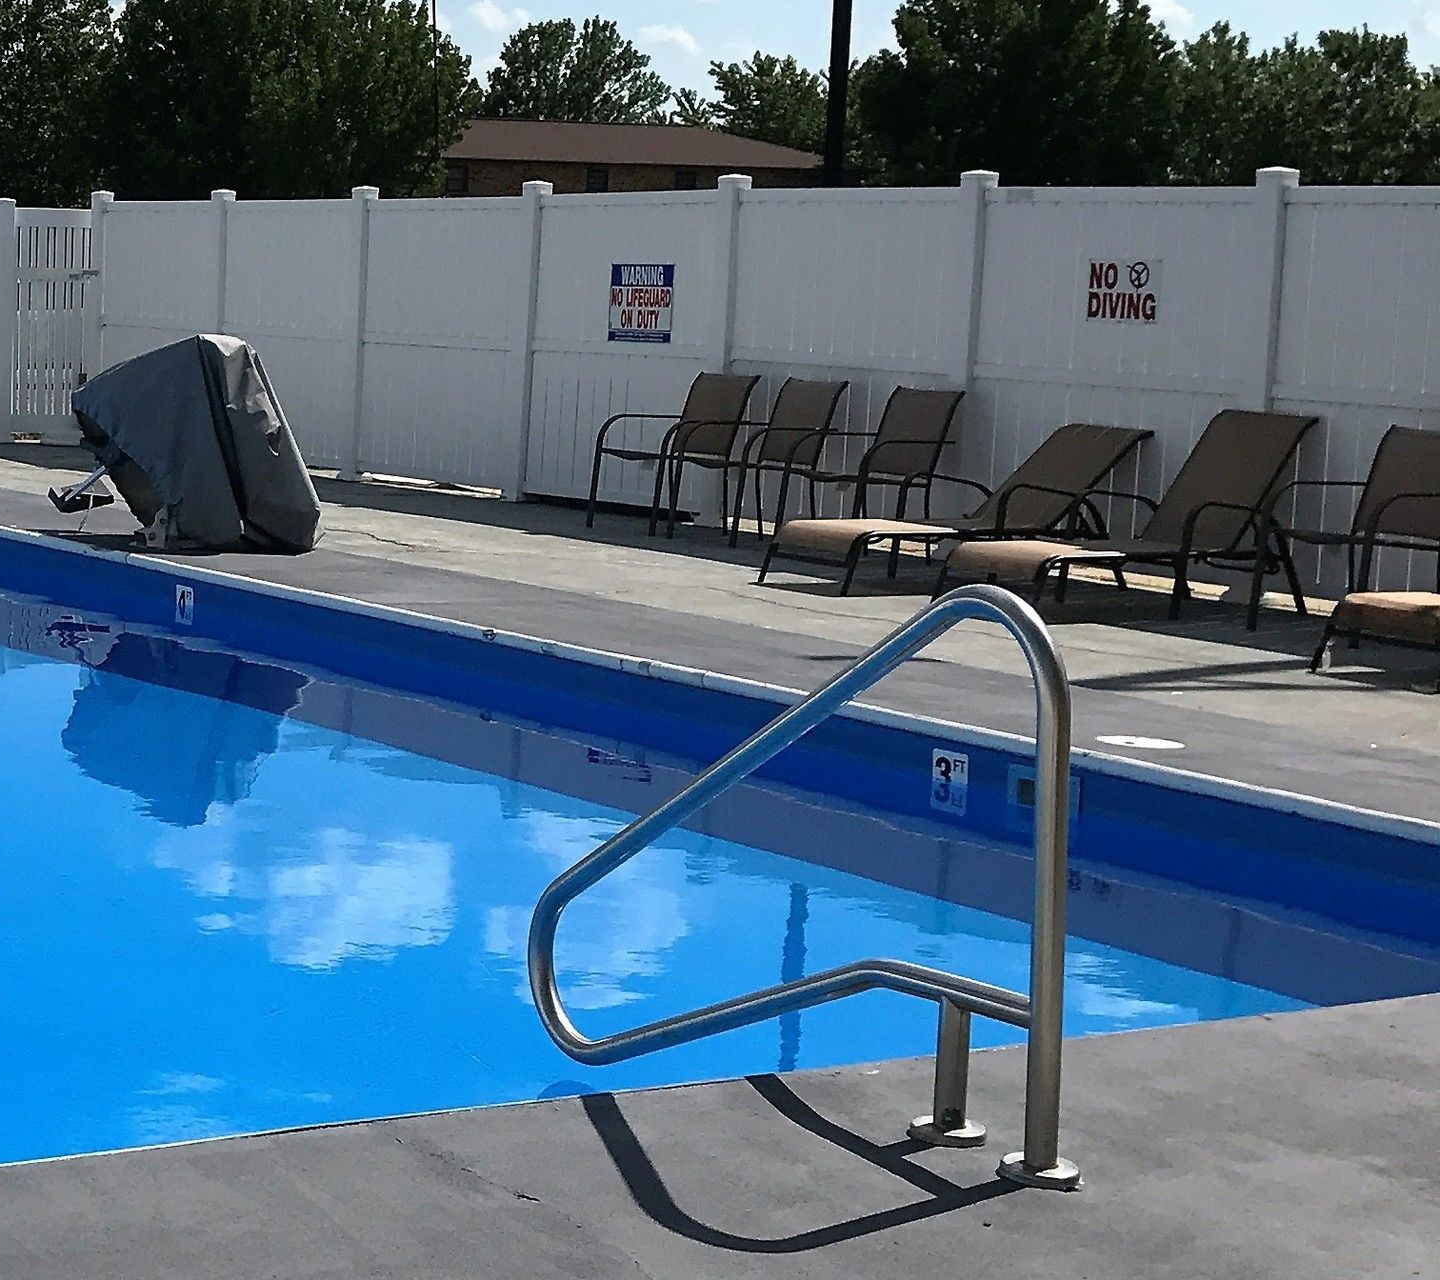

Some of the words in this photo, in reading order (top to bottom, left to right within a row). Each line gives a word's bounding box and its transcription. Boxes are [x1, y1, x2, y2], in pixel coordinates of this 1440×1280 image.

[621, 266, 664, 286] WARNING
[1088, 262, 1119, 290] NO
[611, 288, 624, 308] NO
[626, 288, 671, 308] LIFEGUARD
[1087, 291, 1157, 321] DIVING
[620, 309, 633, 329] ON
[636, 309, 660, 330] DUTY
[935, 756, 952, 784] 3
[953, 758, 966, 773] FT
